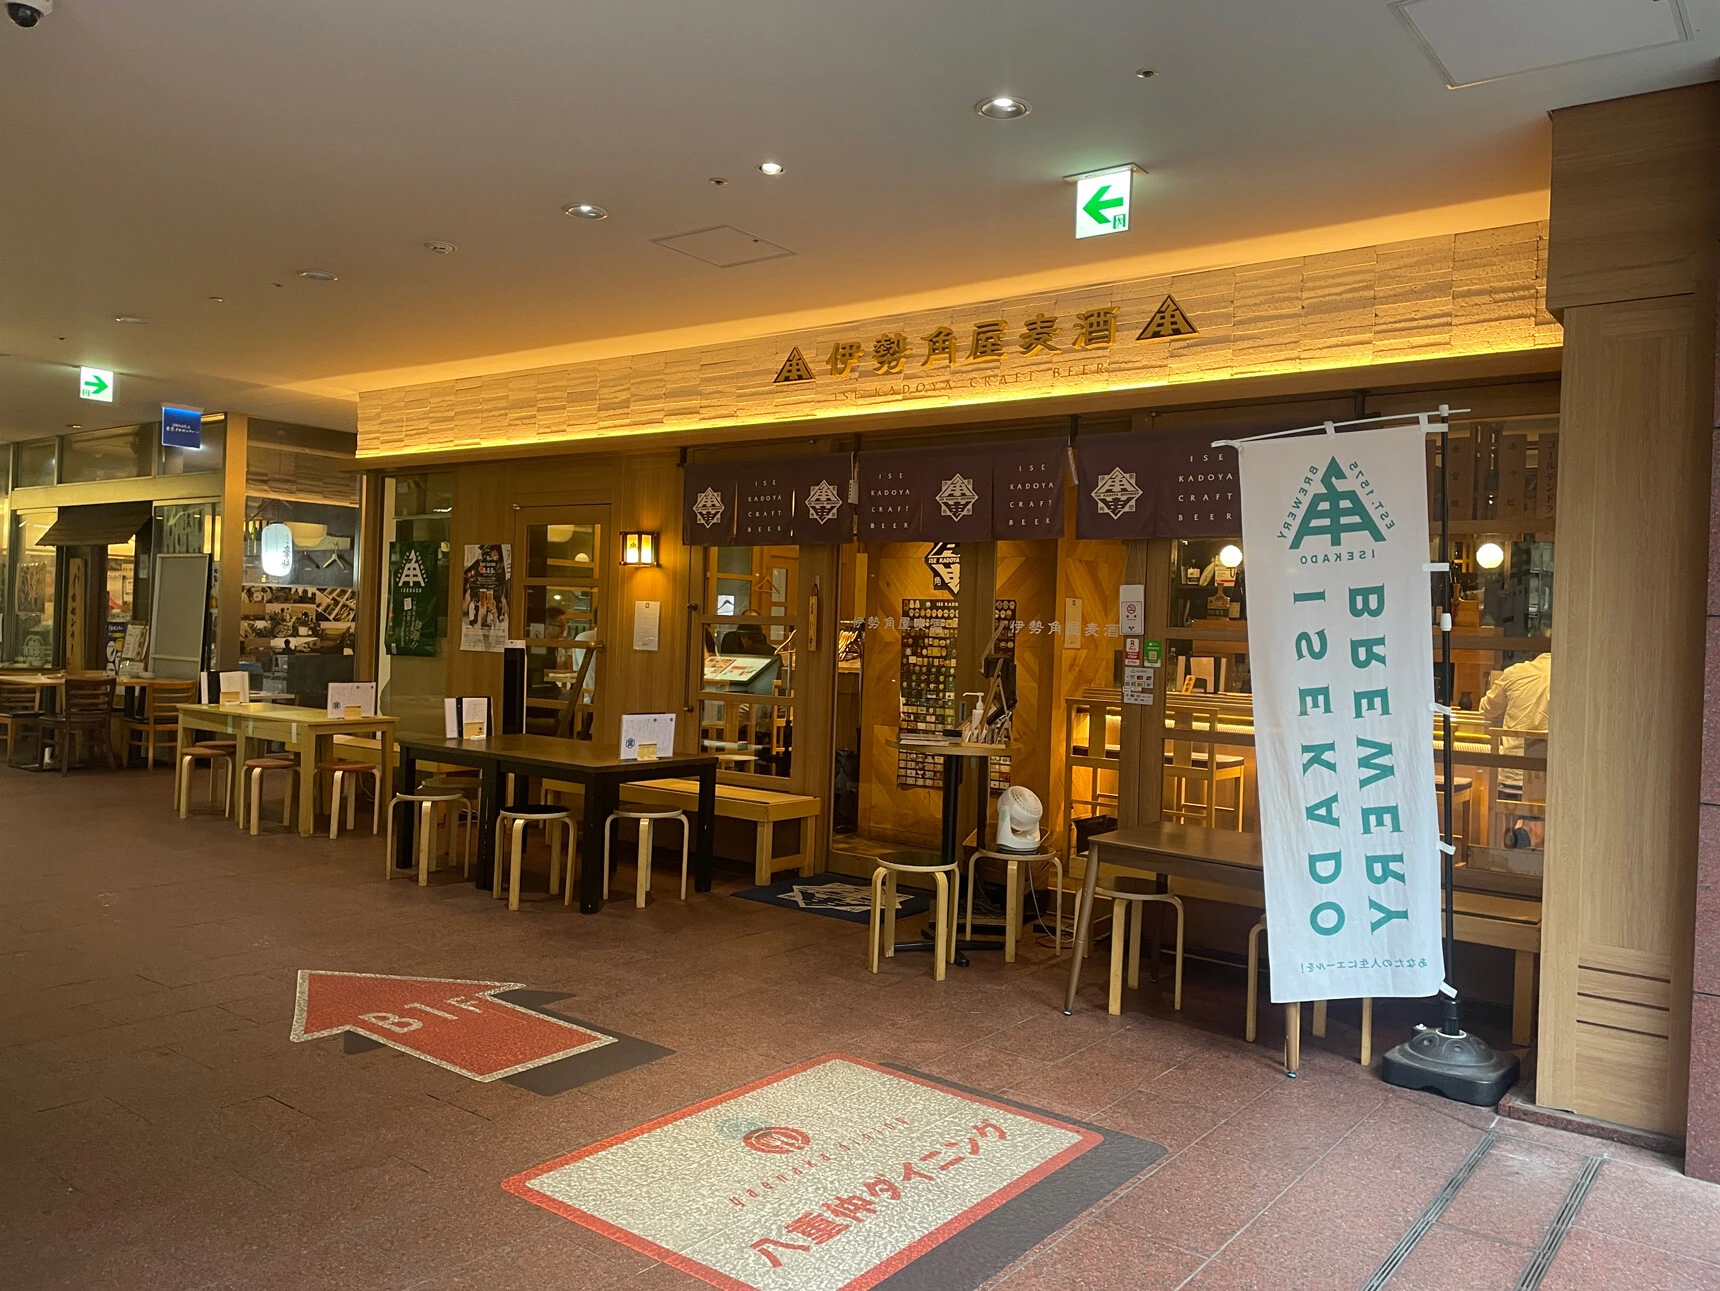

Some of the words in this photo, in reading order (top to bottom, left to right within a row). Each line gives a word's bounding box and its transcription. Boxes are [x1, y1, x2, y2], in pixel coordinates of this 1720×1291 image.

[825, 305, 1121, 379] 伊勢角屋麦酒
[833, 390, 862, 402] ISE
[874, 379, 953, 398] KADOYA
[969, 369, 1038, 388] CRAFT
[1052, 362, 1106, 379] BEER
[1189, 453, 1224, 463] ISE
[1018, 463, 1046, 472] ISE
[878, 472, 904, 480] ISE
[1178, 472, 1233, 483] KADOYA
[755, 479, 777, 487] ISE
[1009, 481, 1054, 490] KADOYA
[870, 488, 911, 496] KADOYA
[748, 494, 782, 502] KADOYA
[1178, 492, 1233, 502] CRAFT
[1009, 499, 1052, 508] CRAFT
[871, 505, 910, 513] CRAFT
[747, 510, 782, 518] CRAFT
[1178, 512, 1233, 521] BEER
[1008, 517, 1051, 526] BEER
[747, 525, 782, 533] BEER
[934, 576, 942, 586] 角
[357, 995, 484, 1034] B1F
[728, 1151, 832, 1209] yaenaka
[837, 1116, 910, 1152] dining
[749, 1118, 1009, 1269] 八重仲ダイニング
